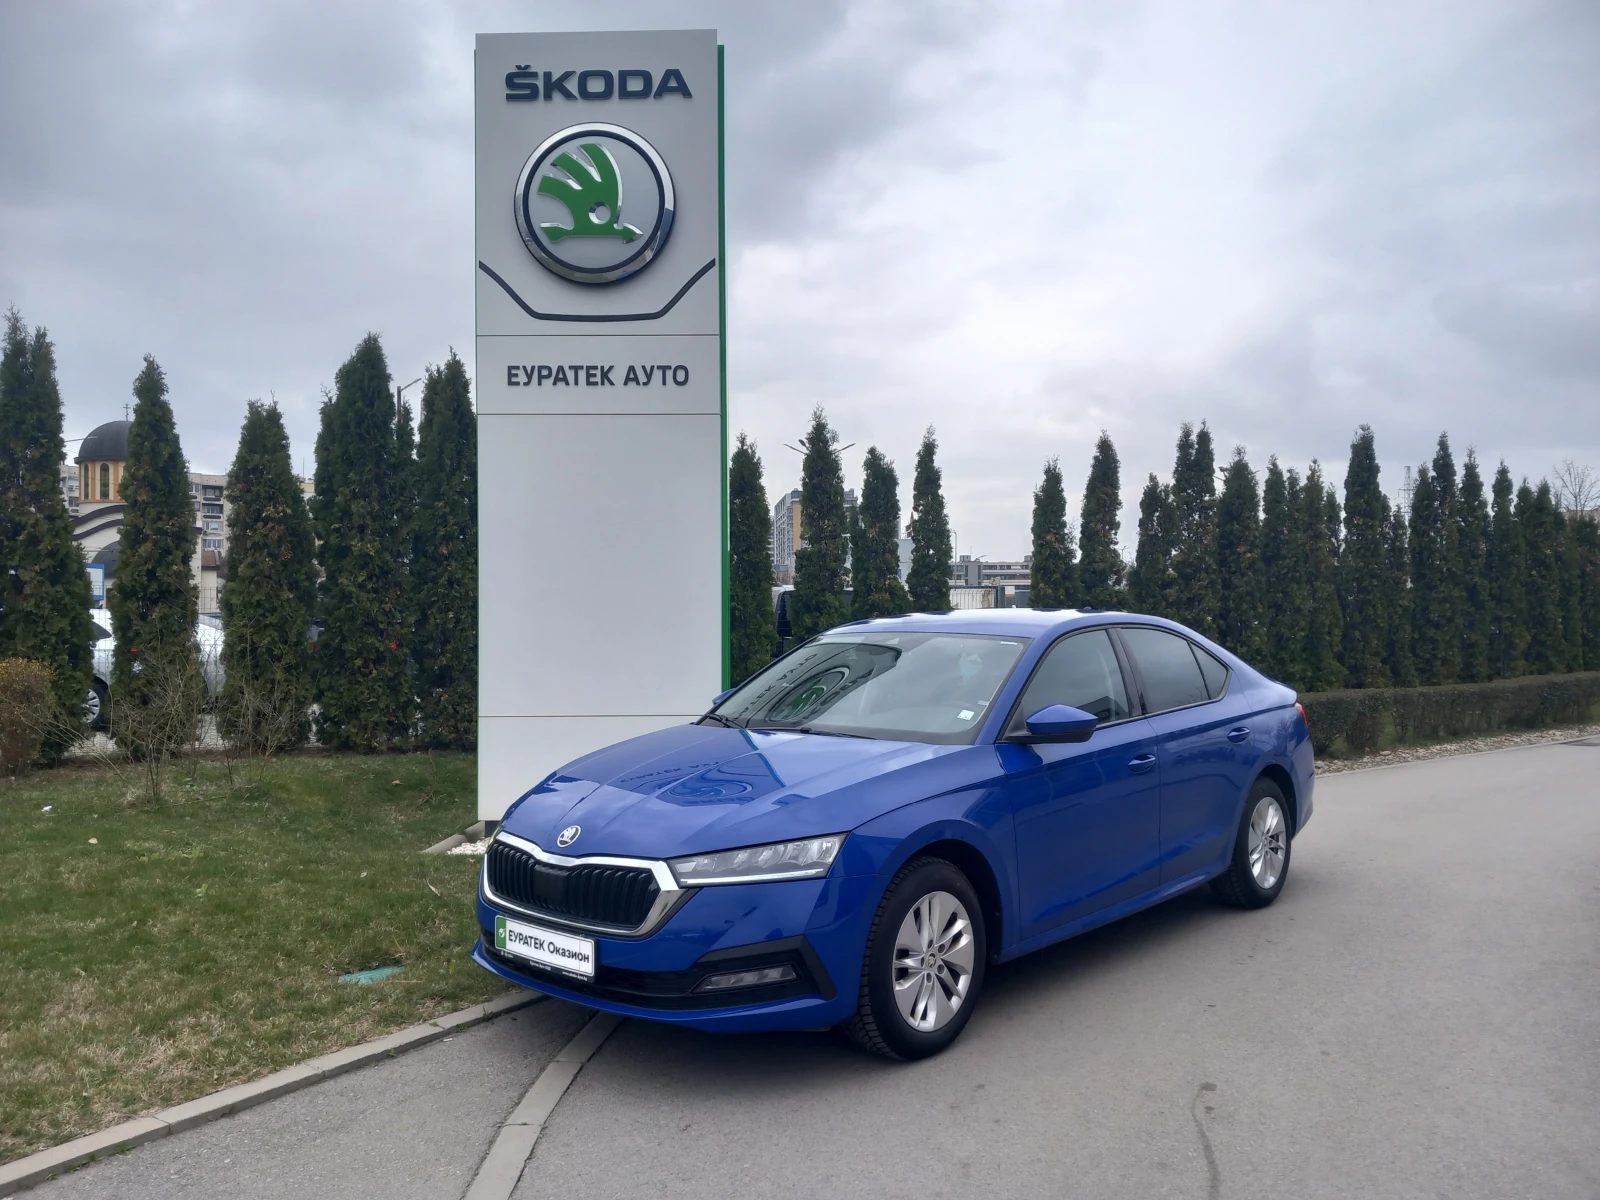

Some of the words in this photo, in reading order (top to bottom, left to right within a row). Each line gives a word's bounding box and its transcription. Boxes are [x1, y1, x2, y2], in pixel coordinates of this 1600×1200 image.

[505, 64, 693, 101] ŠKODA
[507, 365, 615, 386] ЕУРАТЕК
[623, 365, 690, 386] АУТО
[508, 929, 546, 952] ЕУРАТЕК
[547, 941, 590, 964] Оказион
